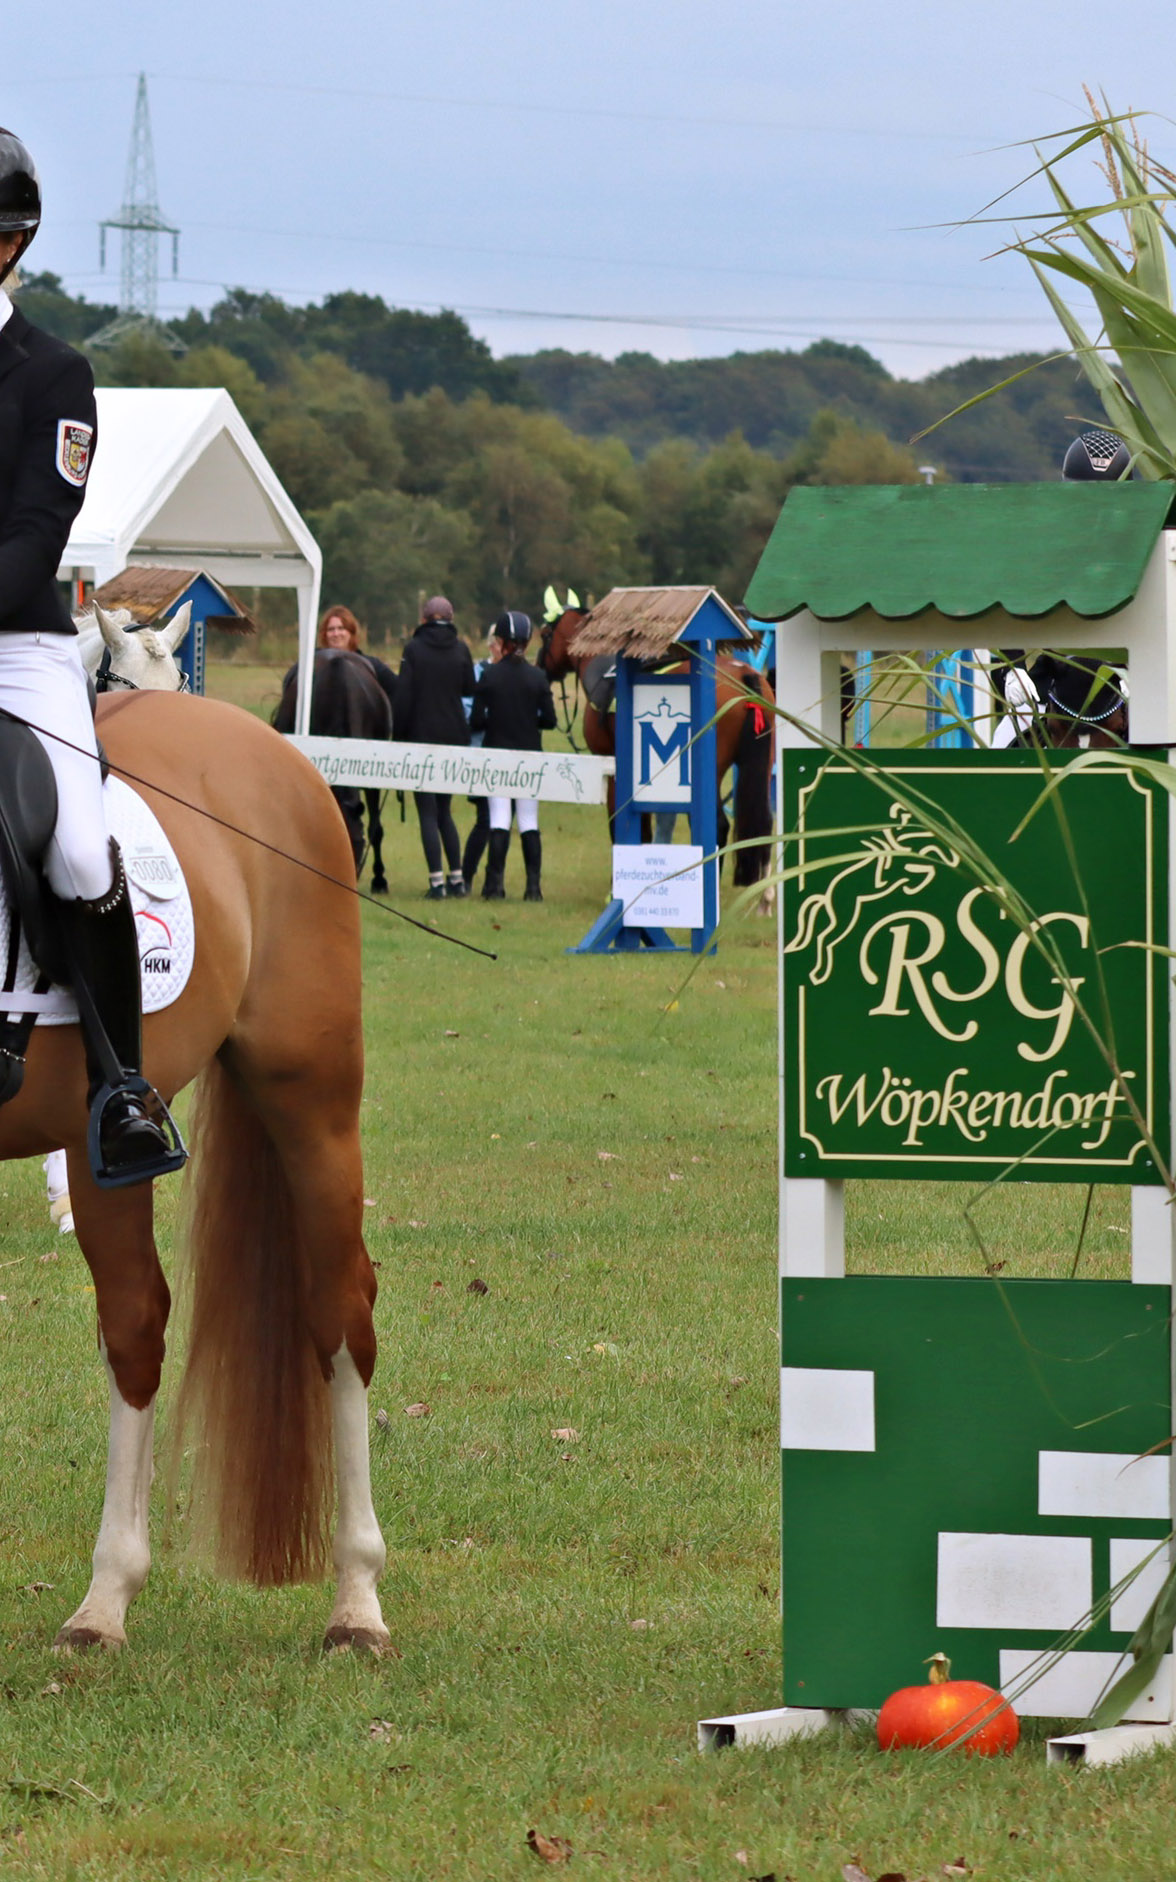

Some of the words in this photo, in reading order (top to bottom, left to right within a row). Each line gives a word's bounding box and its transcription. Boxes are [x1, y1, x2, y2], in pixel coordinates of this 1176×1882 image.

[440, 756, 549, 798] Wöpkendorf
[144, 958, 171, 974] HKM
[859, 885, 1089, 1062] RSG
[816, 1067, 1136, 1150] Wöpkendorf
